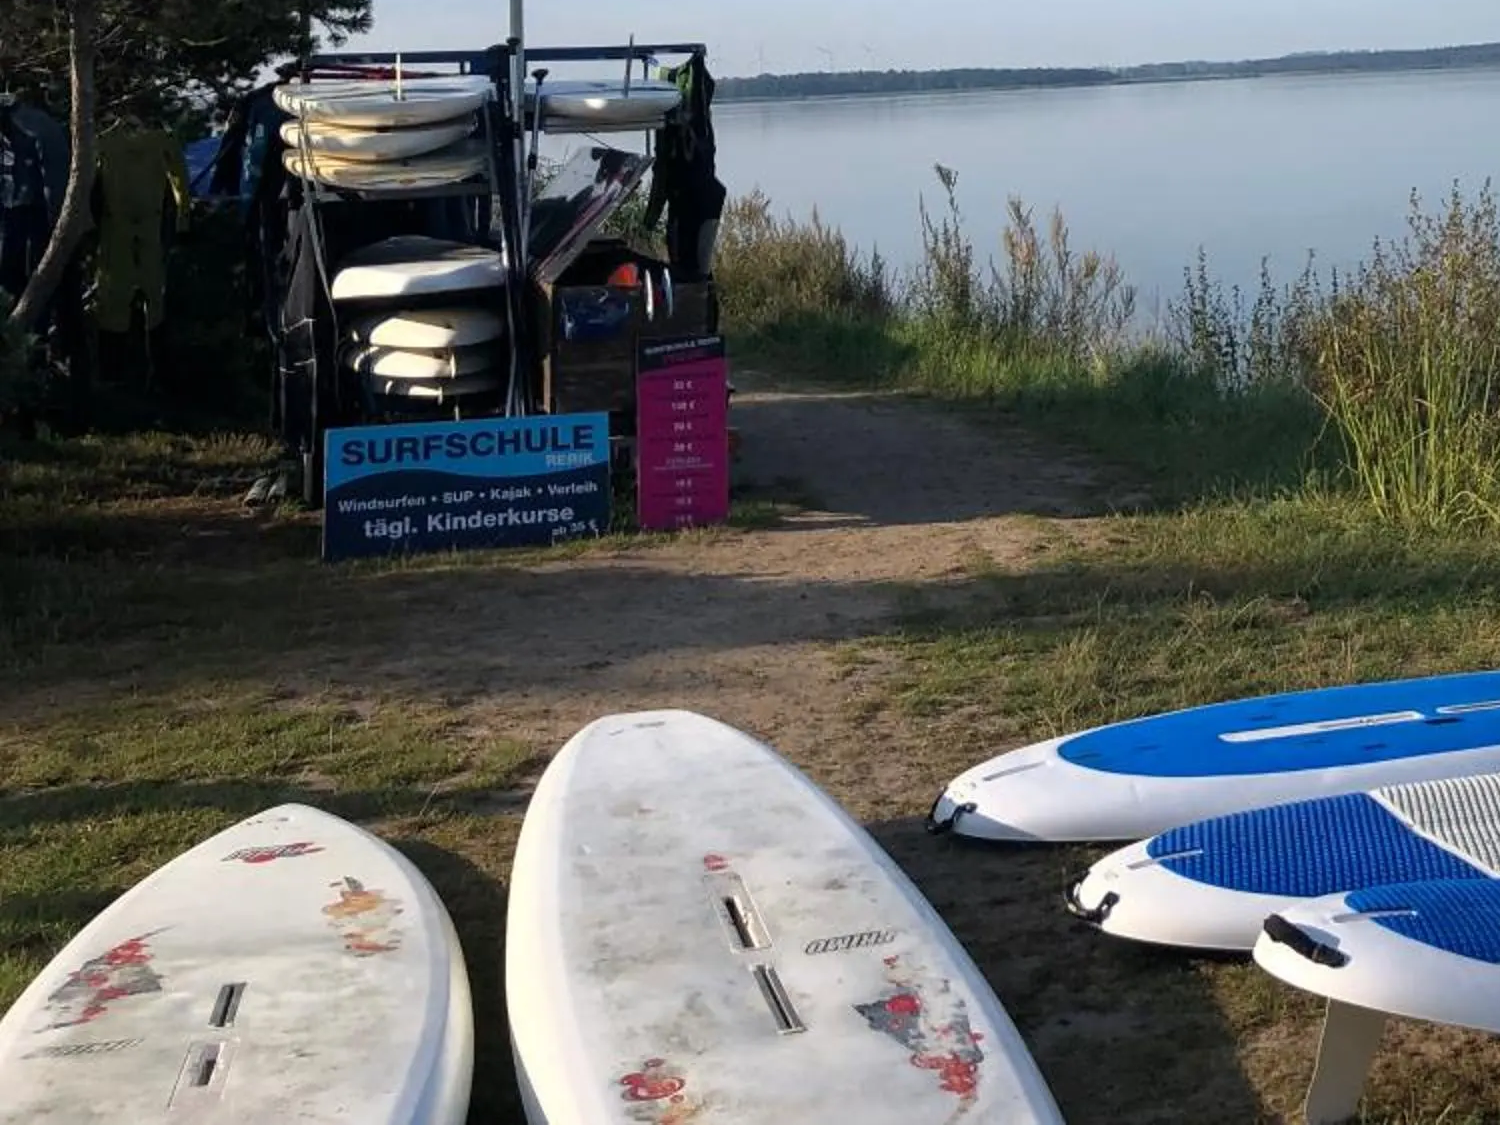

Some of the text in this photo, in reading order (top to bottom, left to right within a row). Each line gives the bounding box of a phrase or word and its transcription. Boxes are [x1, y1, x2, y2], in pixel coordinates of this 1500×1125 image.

[341, 425, 595, 466] SURFSCHULE
[545, 452, 594, 468] RERIK
[337, 481, 599, 513] Windsurfen SUP Kajak Verleih
[364, 506, 575, 539] tägl. Kinderkurse
